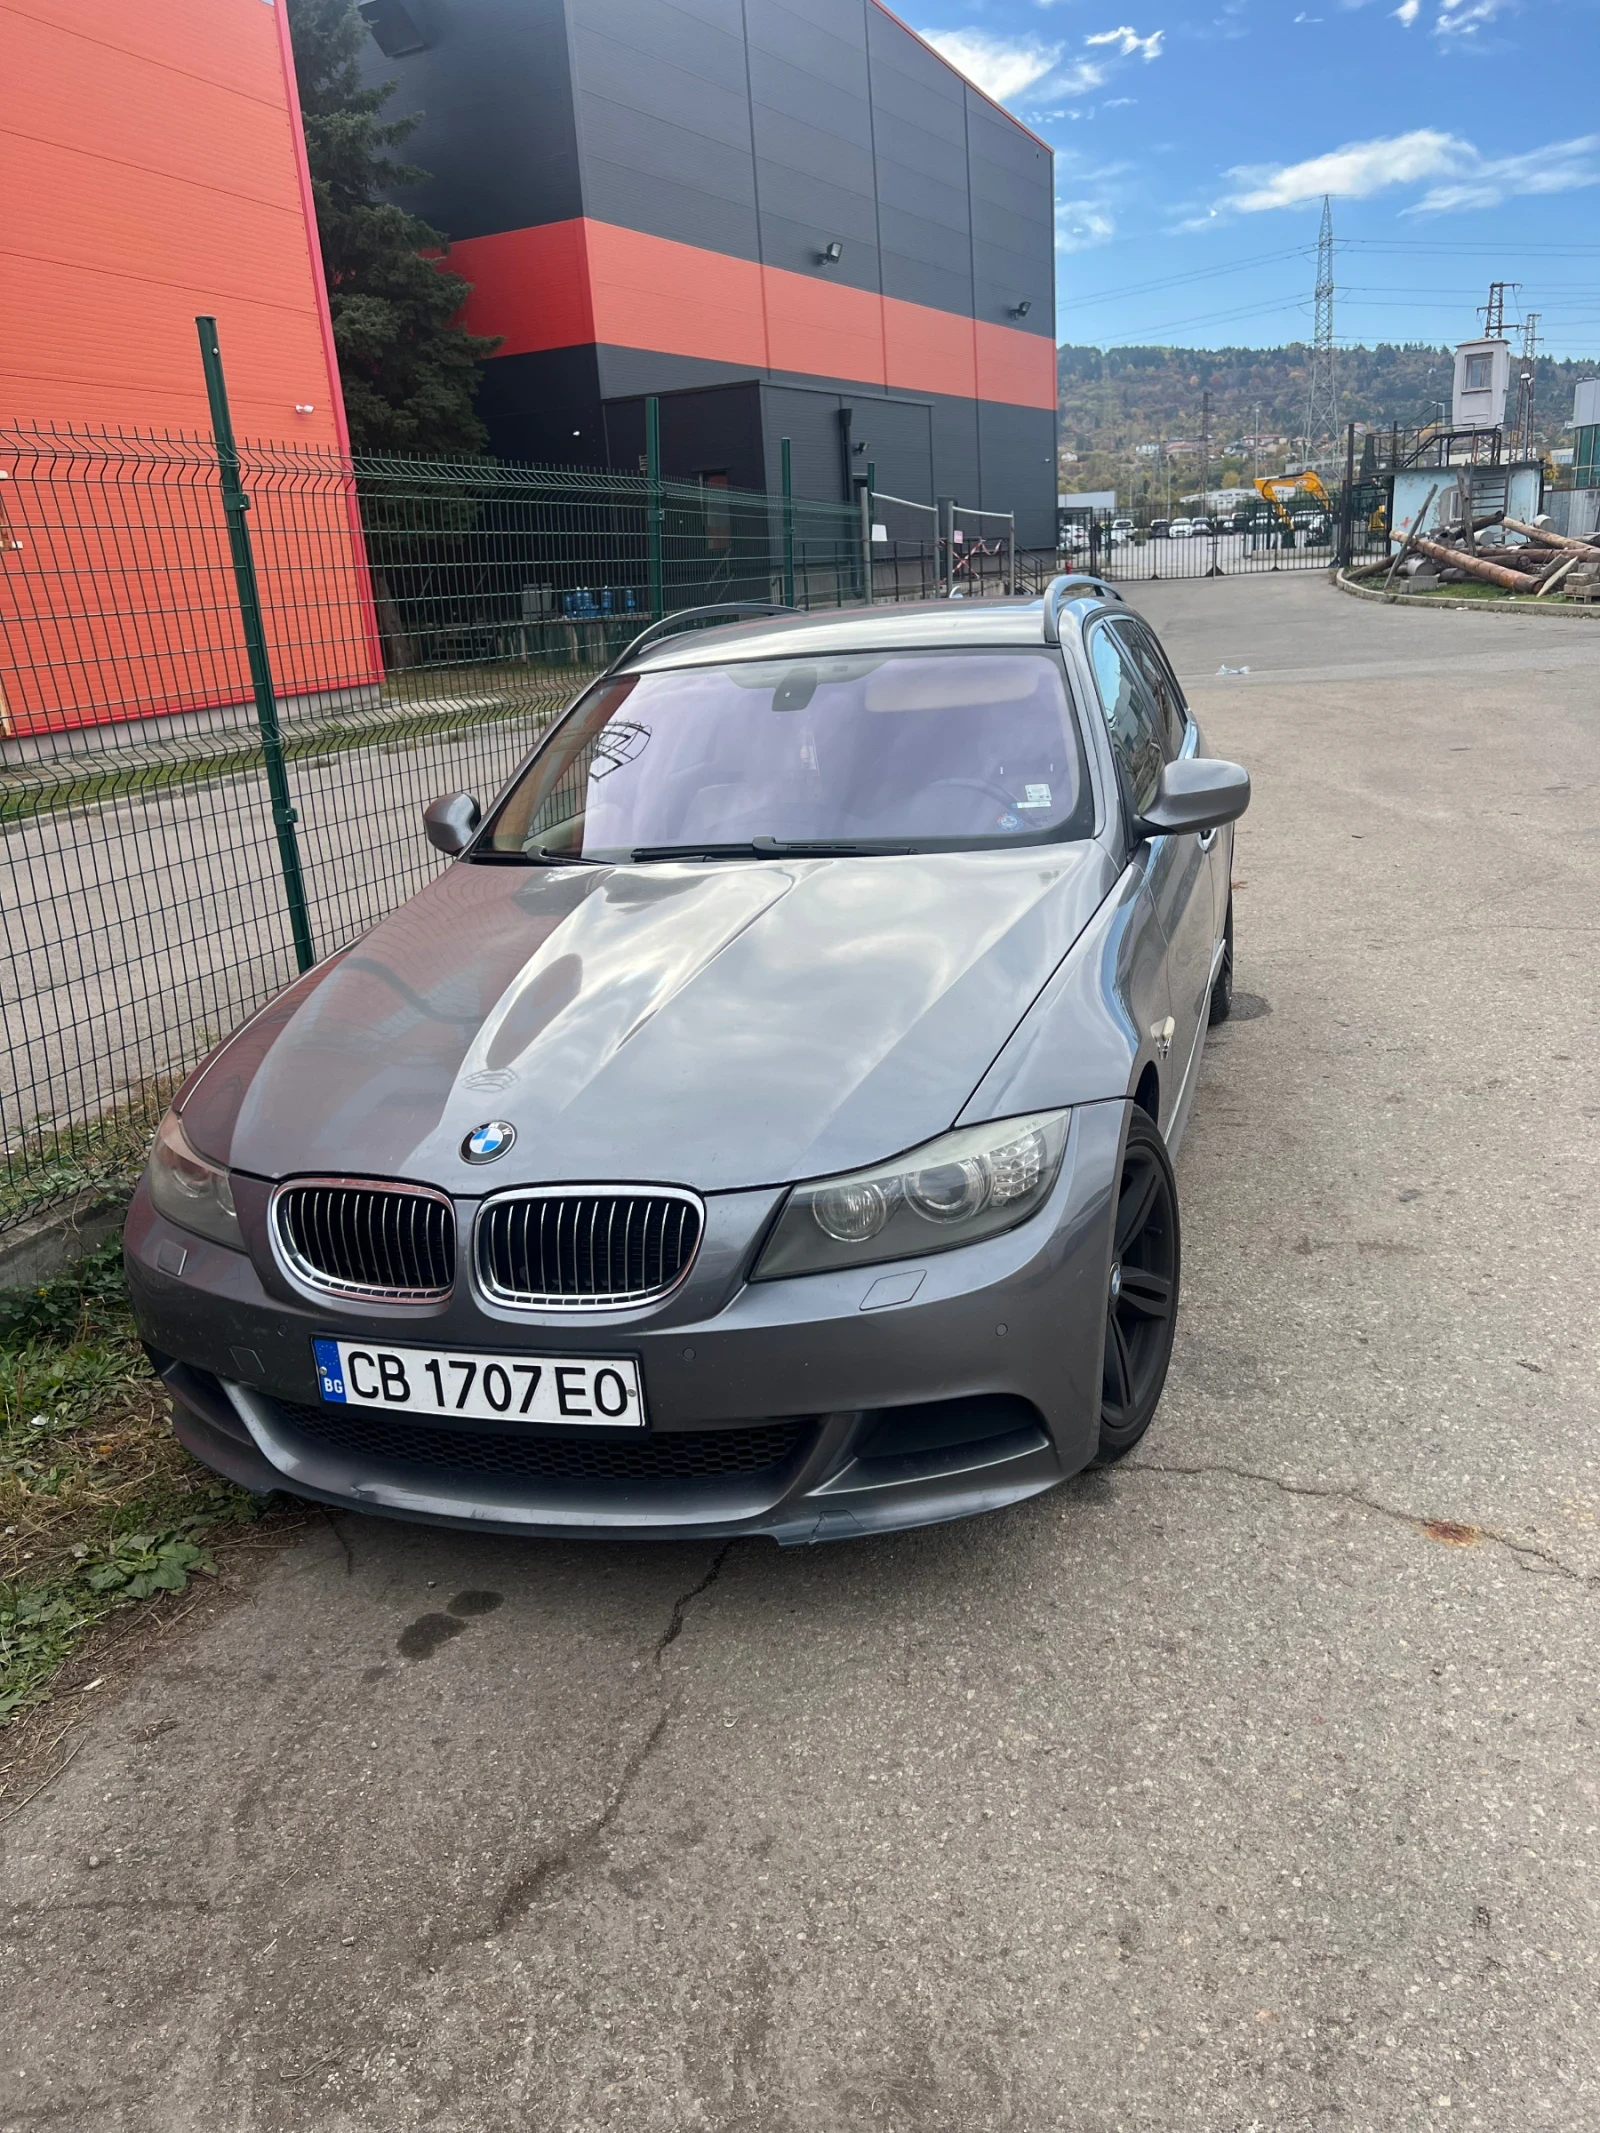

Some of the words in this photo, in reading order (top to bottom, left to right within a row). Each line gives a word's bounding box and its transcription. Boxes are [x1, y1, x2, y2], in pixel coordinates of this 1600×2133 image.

[324, 1377, 343, 1394] BG
[348, 1351, 410, 1402] CB
[425, 1359, 541, 1413] 1707
[555, 1367, 628, 1417] EO
